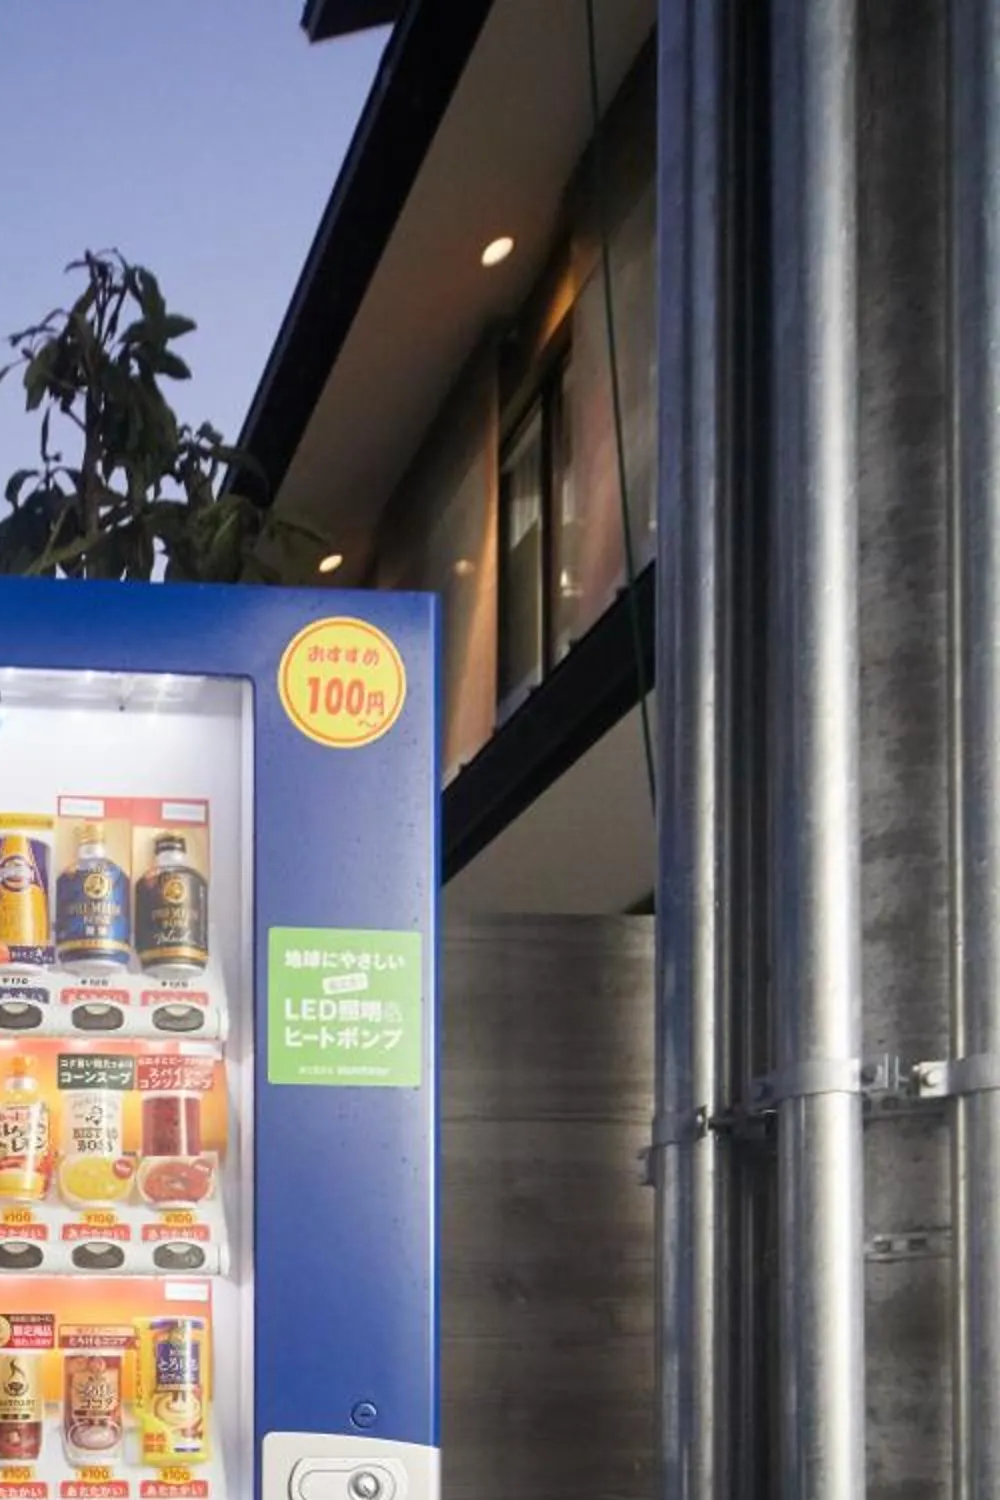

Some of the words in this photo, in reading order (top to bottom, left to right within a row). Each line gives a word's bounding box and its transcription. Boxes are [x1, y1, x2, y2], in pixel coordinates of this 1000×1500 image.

[307, 645, 381, 666] おすすめ
[306, 677, 385, 717] 100円
[285, 1026, 404, 1051] ヒートポンプ
[60, 1071, 132, 1085] コーンスープ
[66, 1486, 124, 1497] あたたかい
[146, 1485, 204, 1496] あたたかい
